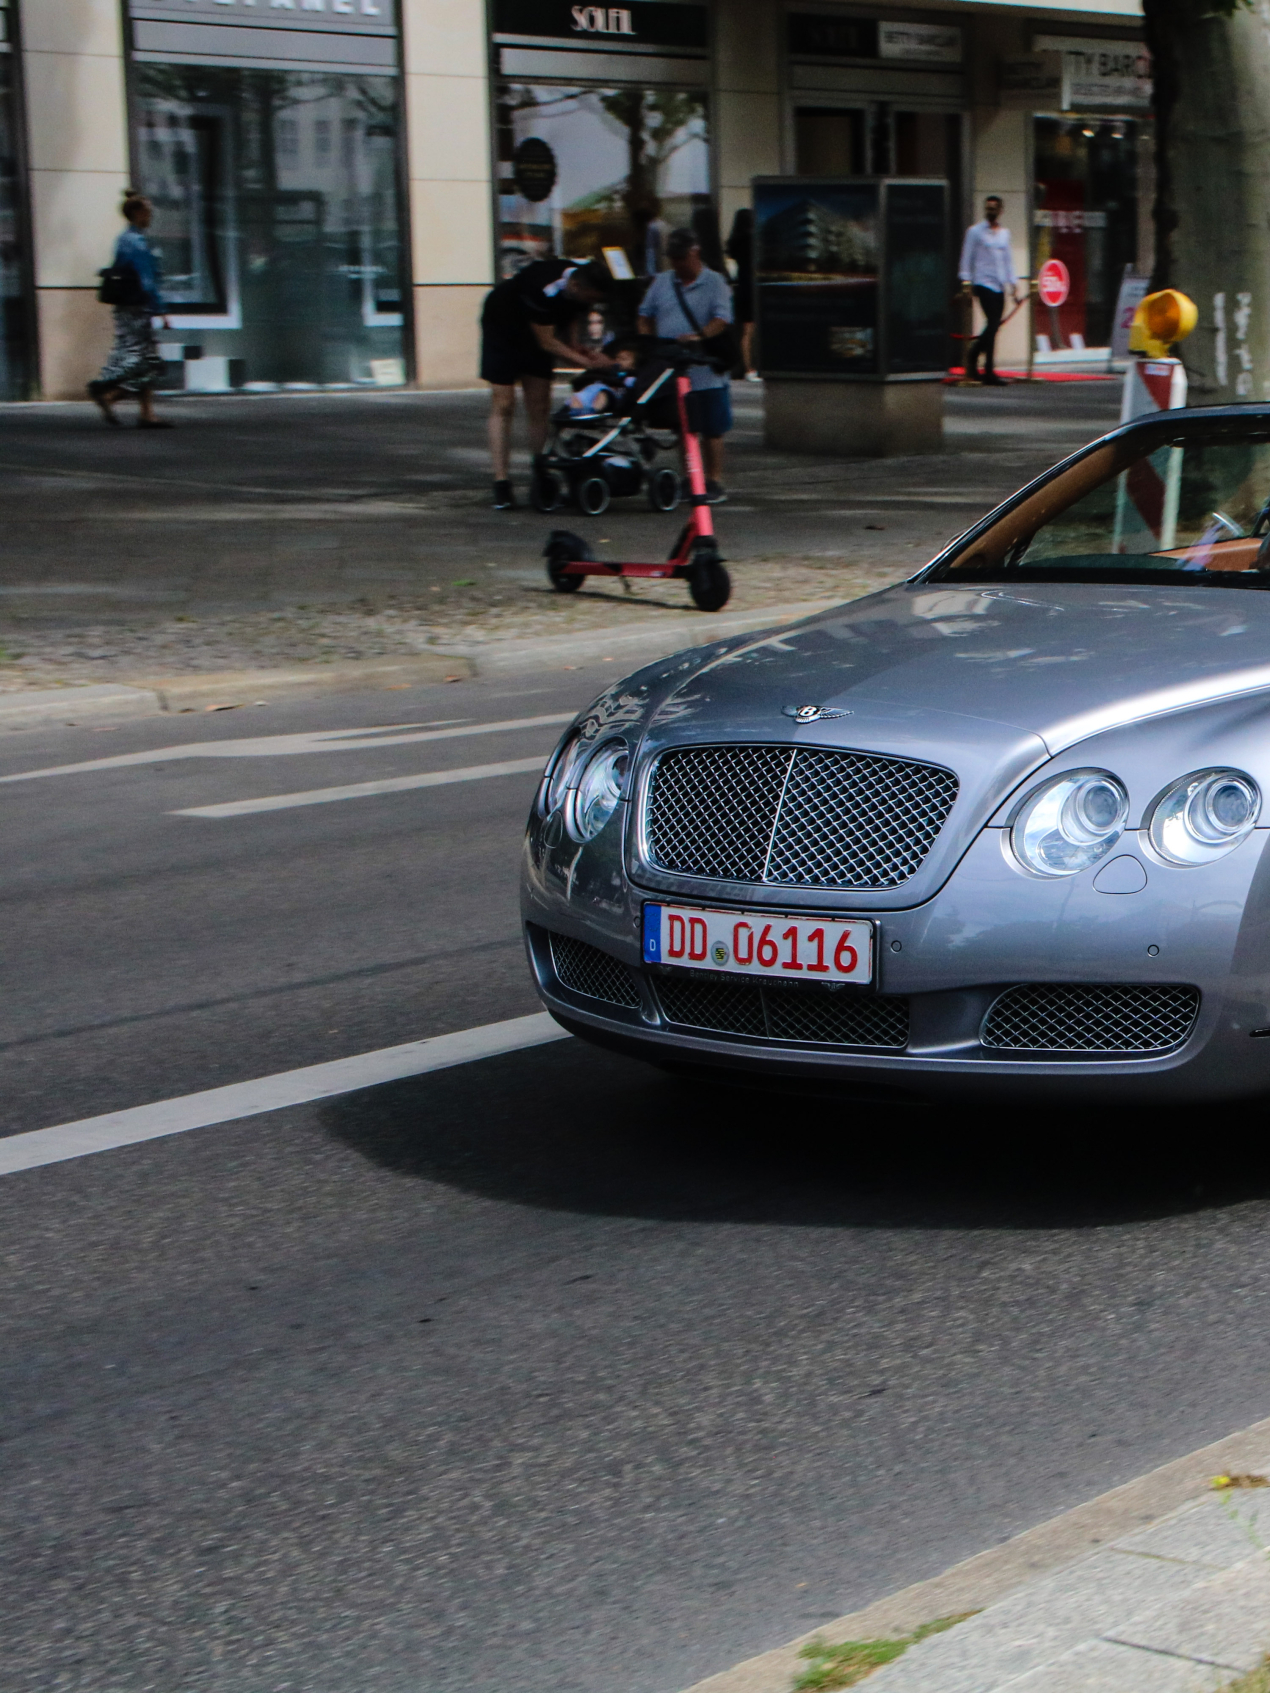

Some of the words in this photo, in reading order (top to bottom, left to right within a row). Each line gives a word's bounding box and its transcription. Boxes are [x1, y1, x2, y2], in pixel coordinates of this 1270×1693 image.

[570, 5, 637, 35] SOLEIL
[650, 939, 656, 951] D
[668, 914, 708, 962] DD
[733, 922, 858, 973] 06116
[689, 969, 718, 982] Bentley
[720, 972, 750, 984] Service
